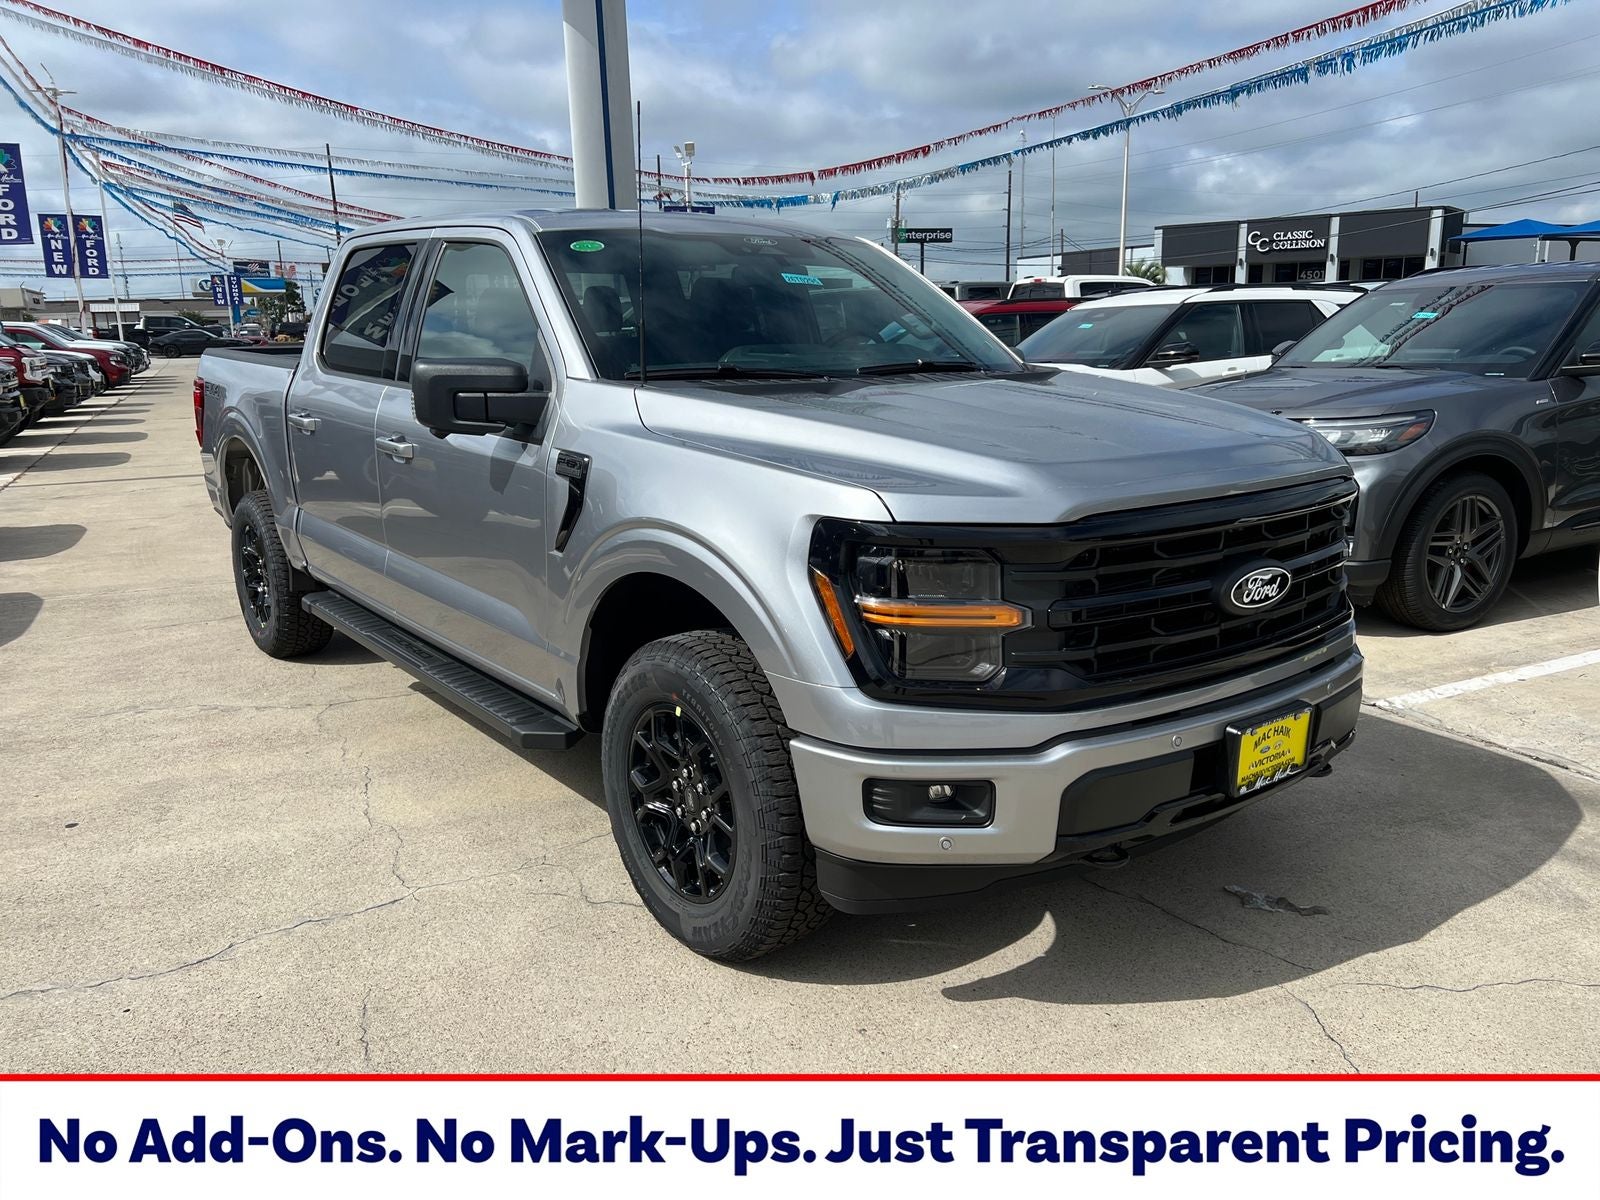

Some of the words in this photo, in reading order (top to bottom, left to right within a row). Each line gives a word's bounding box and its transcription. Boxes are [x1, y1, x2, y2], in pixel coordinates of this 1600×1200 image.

[0, 184, 18, 240] FORD
[898, 230, 952, 241] enterprise
[1272, 239, 1326, 250] COLLISION
[1273, 230, 1313, 240] CLASSIC
[50, 239, 67, 275] NEW
[85, 240, 100, 275] FORD
[1300, 270, 1325, 279] 4501
[216, 287, 225, 305] NEW
[230, 276, 239, 305] HYUNDAI
[1243, 573, 1281, 603] Ford
[1253, 728, 1272, 752] MAC
[1273, 724, 1292, 740] HAIK
